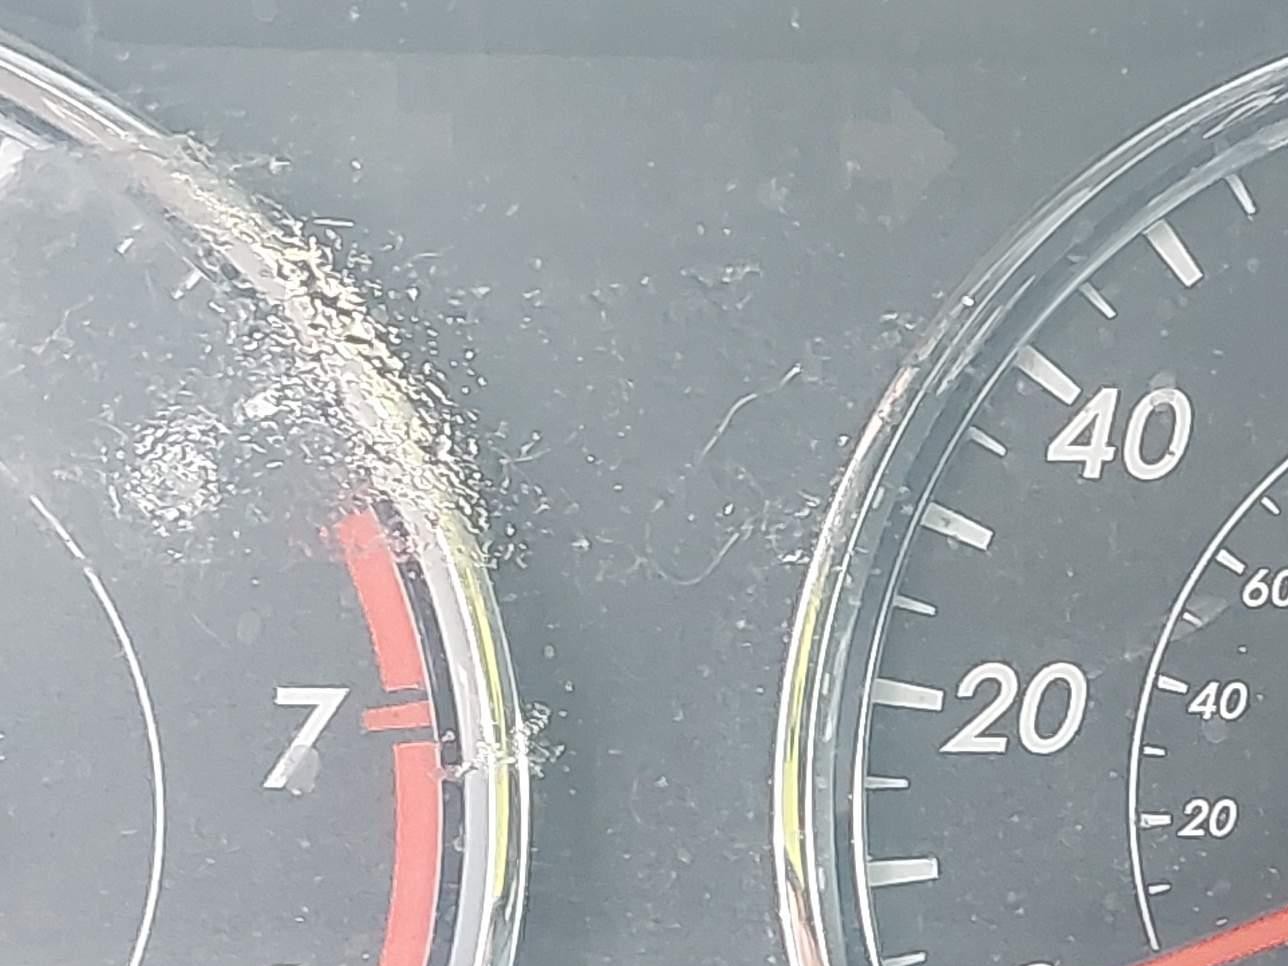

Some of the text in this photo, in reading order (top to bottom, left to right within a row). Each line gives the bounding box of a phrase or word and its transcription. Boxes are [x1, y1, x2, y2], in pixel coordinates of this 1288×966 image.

[1047, 387, 1193, 481] 40
[262, 686, 351, 789] 7
[940, 660, 1090, 756] 20
[1187, 680, 1250, 721] 40
[1177, 798, 1238, 838] 20
